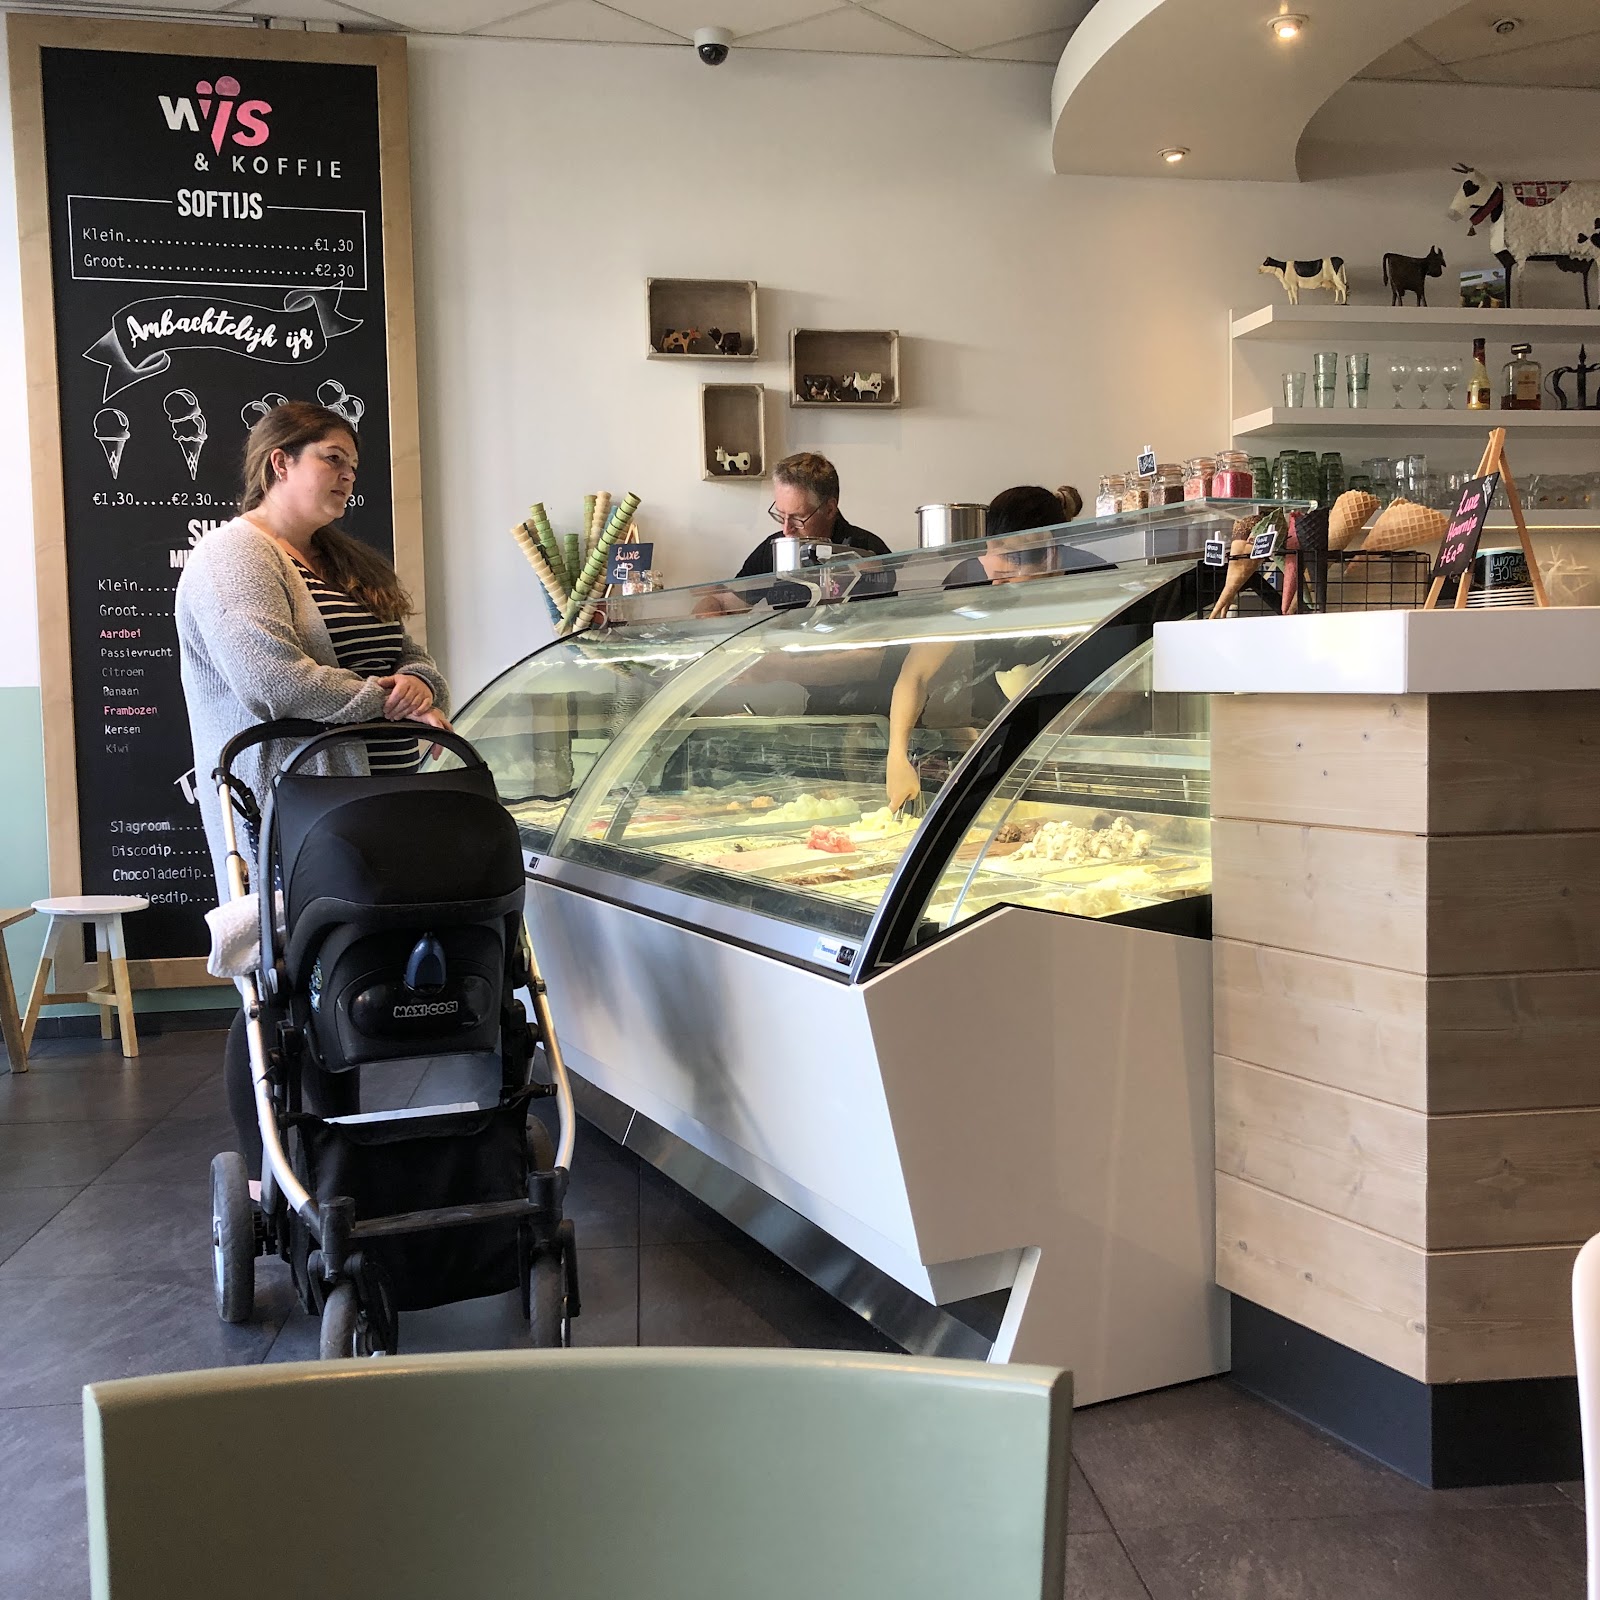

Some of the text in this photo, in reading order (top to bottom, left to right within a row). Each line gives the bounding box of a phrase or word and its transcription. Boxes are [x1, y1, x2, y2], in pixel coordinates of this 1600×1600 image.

[194, 152, 342, 179] & KOFFIE
[176, 188, 264, 221] SOFTIJS
[82, 227, 355, 254] Klein €1,30
[83, 253, 355, 279] Groot €2,30
[126, 306, 315, 359] Ambachtelijk ijs
[92, 491, 134, 507] €1,30
[1455, 489, 1481, 517] Luxe
[614, 546, 641, 562] Luxe
[98, 578, 138, 592] Klein
[99, 604, 139, 618] Groot
[100, 628, 142, 639] Aardbei
[101, 648, 173, 658] Passievrucht
[102, 667, 145, 677] Citroen
[104, 705, 158, 716] Frambozen
[104, 724, 141, 735] Kersen
[106, 743, 129, 754] Kiwi
[110, 820, 171, 835] Slagroom
[112, 843, 172, 858] Discodip
[112, 865, 202, 882] Chocoladedip
